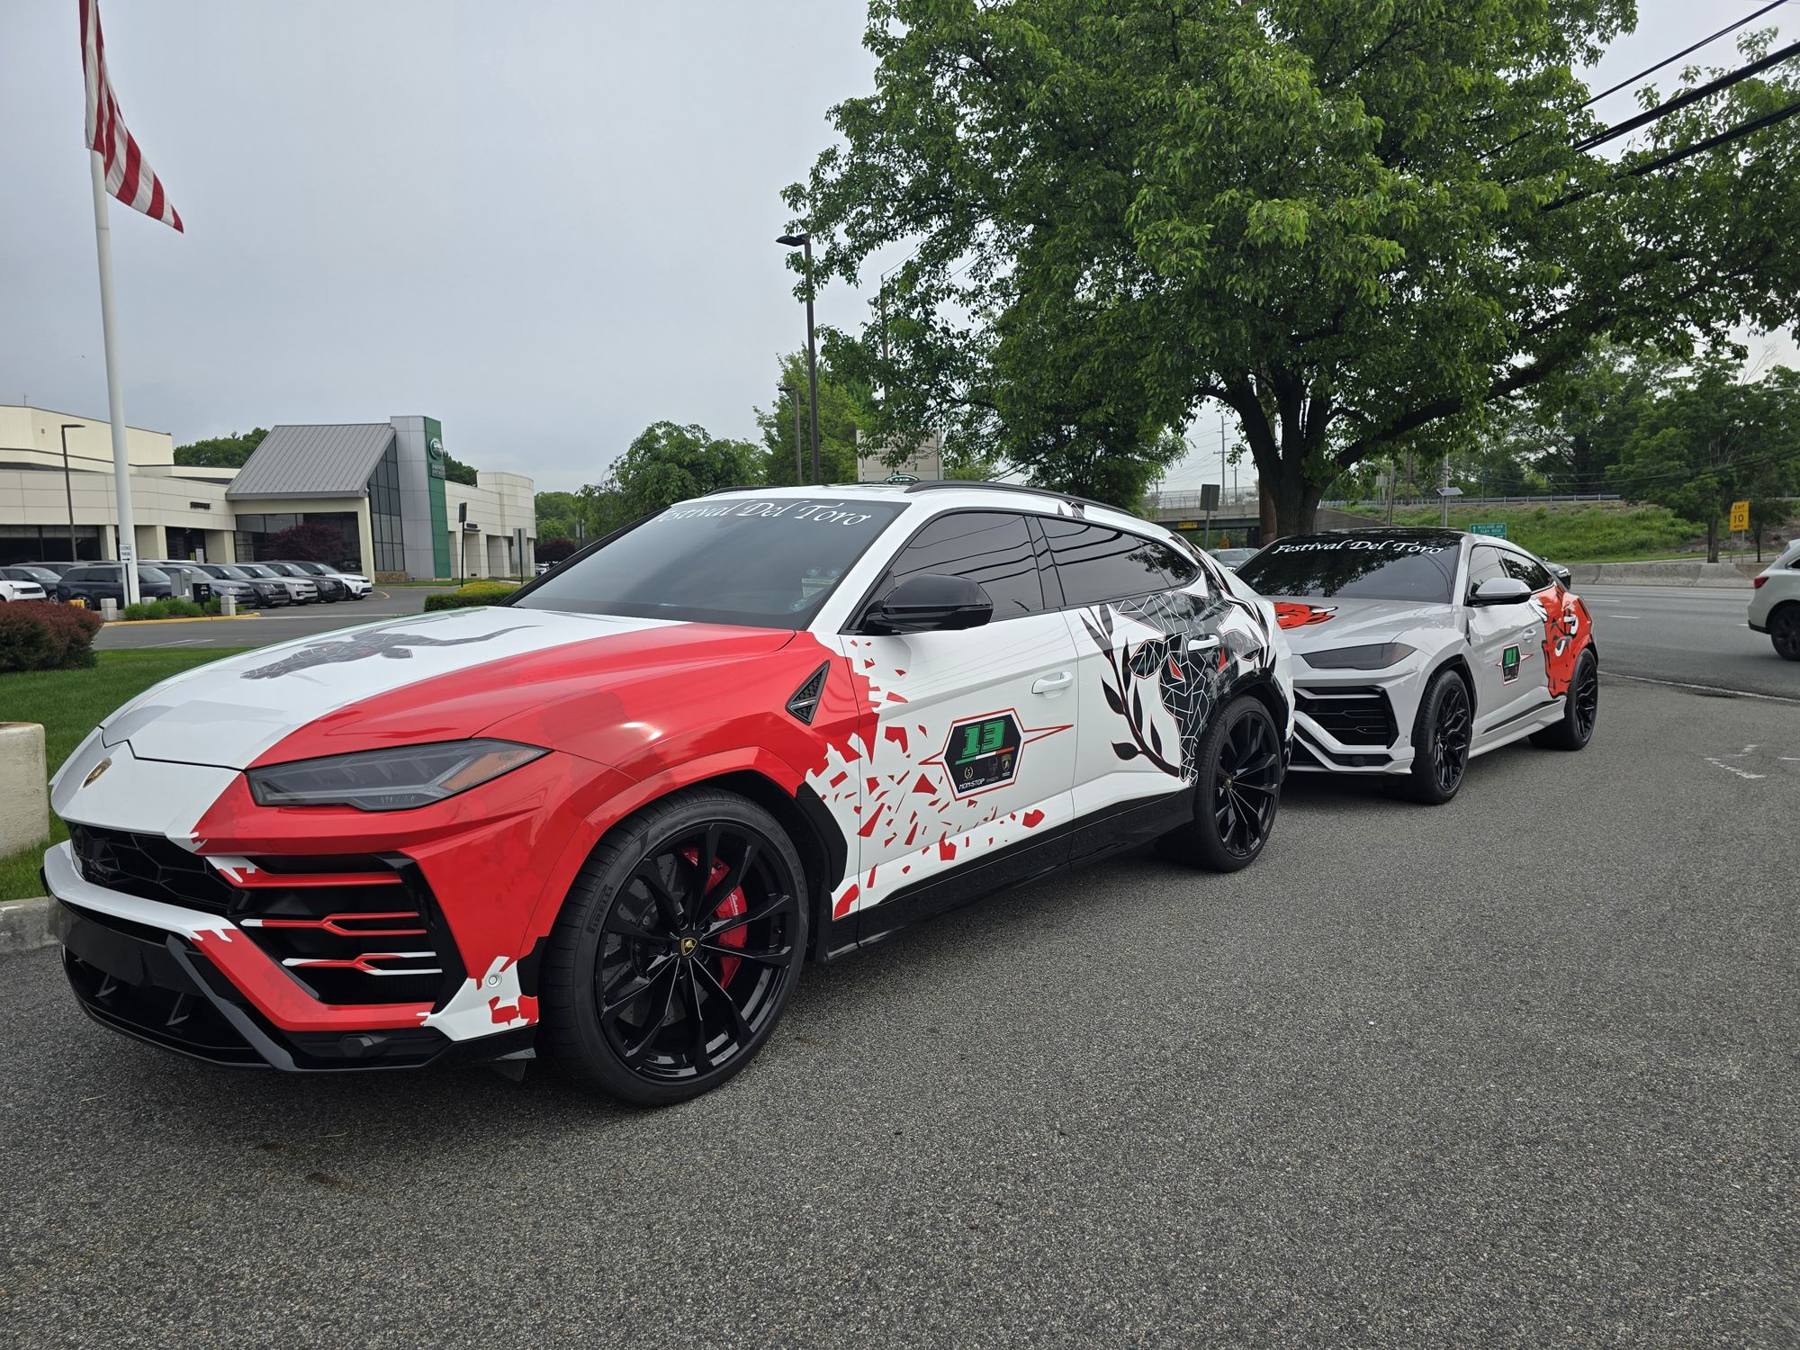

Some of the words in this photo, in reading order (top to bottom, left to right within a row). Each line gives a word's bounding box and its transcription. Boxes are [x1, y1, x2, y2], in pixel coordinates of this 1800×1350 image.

[736, 500, 811, 518] Del
[794, 502, 872, 526] Toro
[1733, 513, 1745, 524] 10
[1271, 539, 1353, 555] Festival
[1348, 540, 1395, 550] Del
[1392, 541, 1444, 554] Toro
[961, 719, 1005, 758] 13
